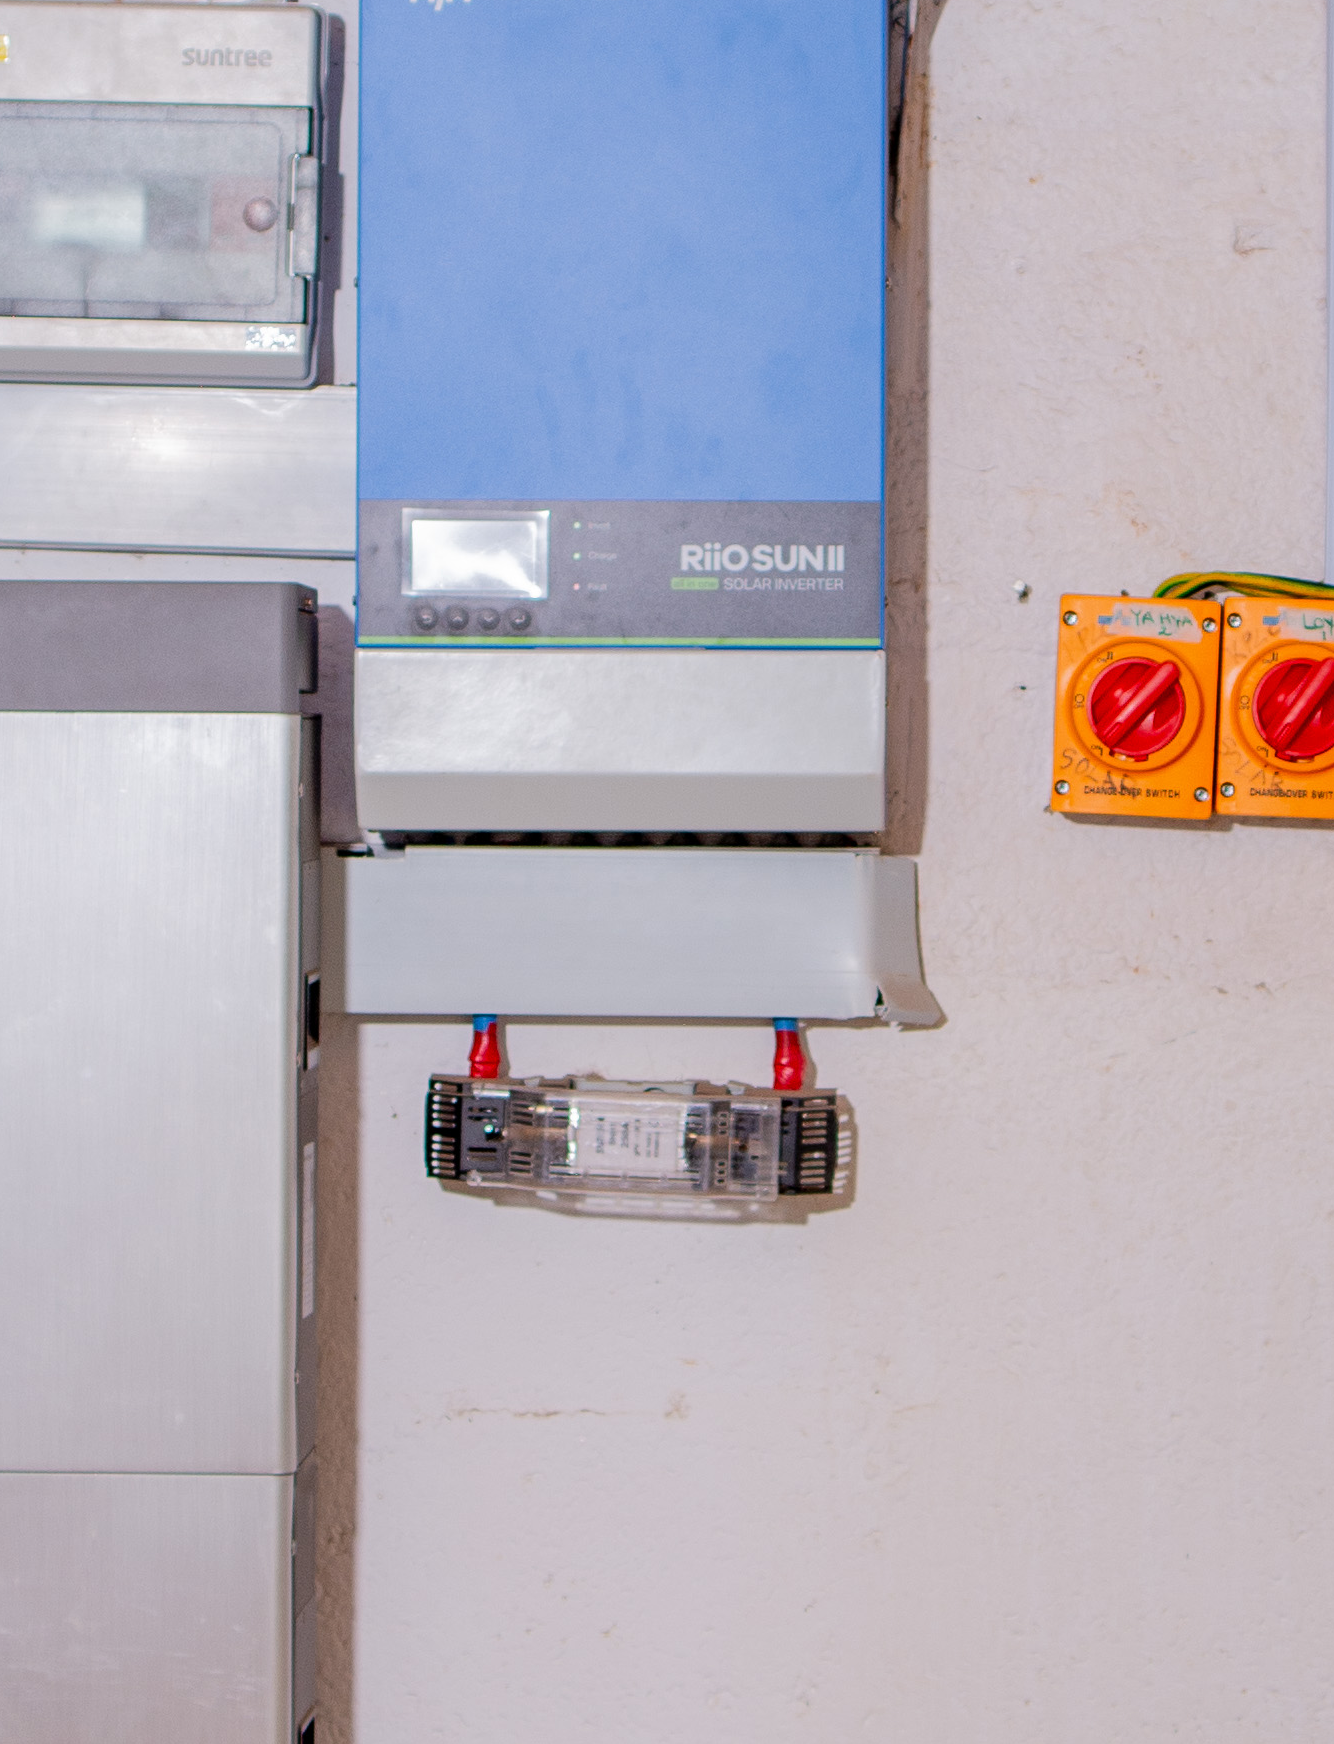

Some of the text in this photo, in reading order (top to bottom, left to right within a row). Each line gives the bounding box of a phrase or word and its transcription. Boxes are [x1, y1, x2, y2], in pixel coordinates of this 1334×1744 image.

[181, 47, 272, 67] suntree
[723, 577, 772, 590] SOLAR
[775, 577, 844, 591] INVERTER
[1146, 789, 1180, 798] SWITCH
